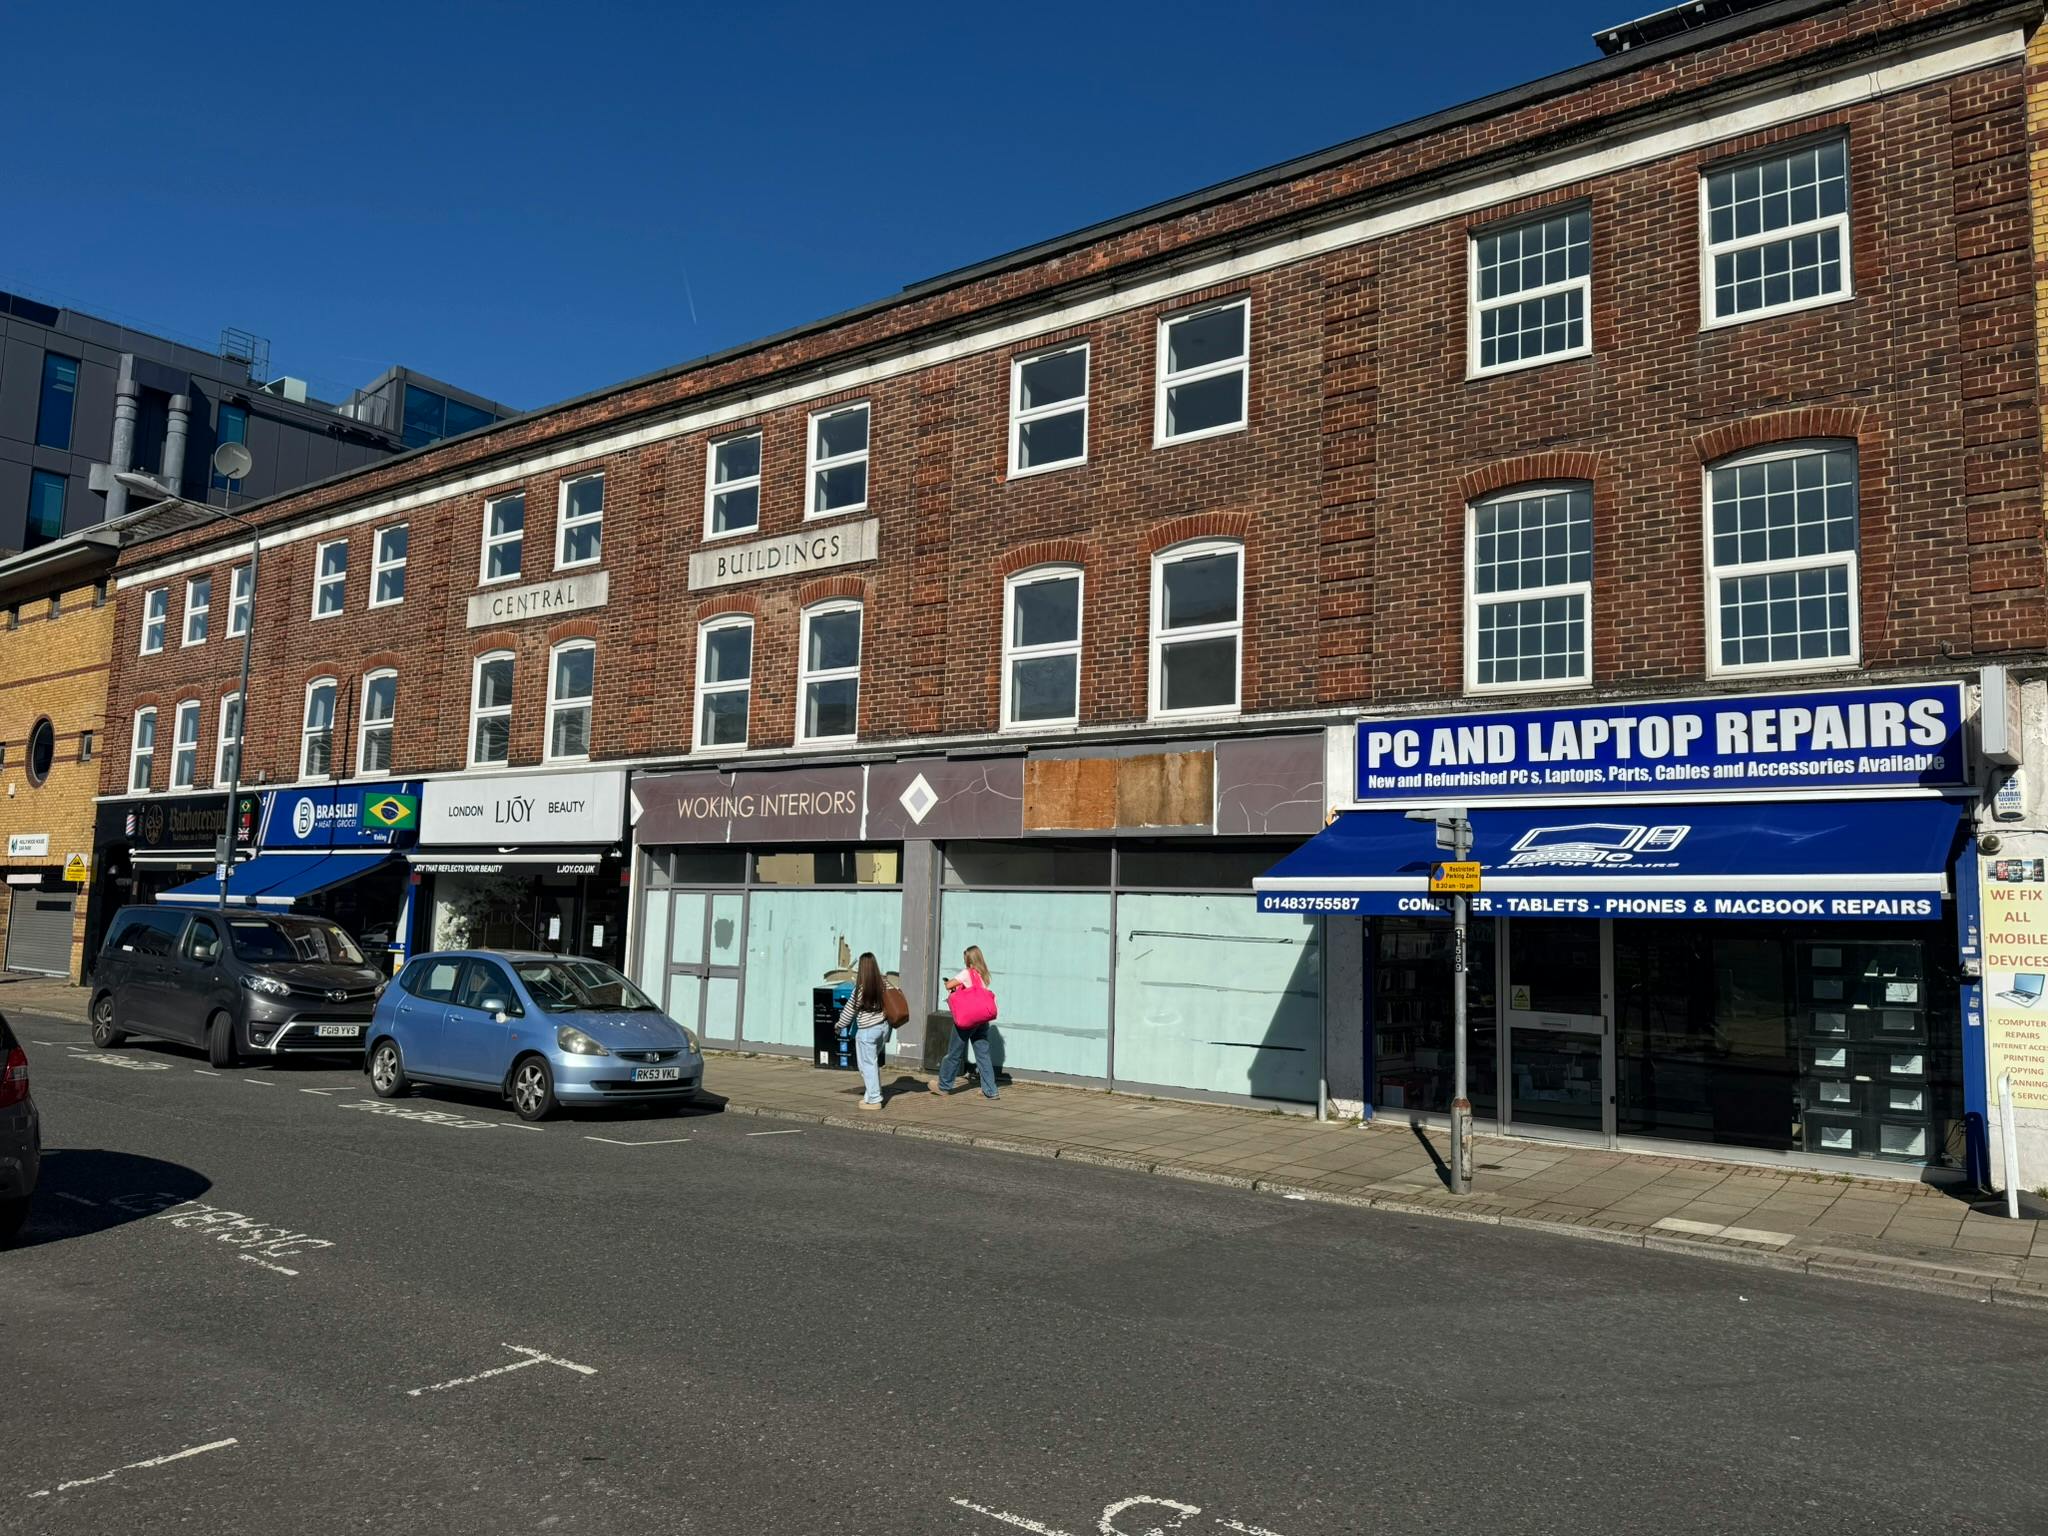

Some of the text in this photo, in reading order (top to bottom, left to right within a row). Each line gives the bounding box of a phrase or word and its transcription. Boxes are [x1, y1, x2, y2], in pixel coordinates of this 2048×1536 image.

[717, 534, 840, 577] BUILDINGS
[492, 584, 576, 617] CENTRAL
[1368, 699, 1946, 768] PC AND LAPTOP REPAIRS
[1368, 775, 1395, 788] New
[1398, 774, 1421, 788] and
[1425, 770, 1506, 787] Refurbished
[1545, 767, 1606, 785] Laptops,
[1608, 765, 1652, 783] Parts,
[1655, 761, 1710, 781] Cables
[1713, 761, 1744, 778] and
[1748, 755, 1855, 778] Accessories
[1858, 753, 1945, 773] Available
[448, 805, 483, 817] LONDON
[548, 800, 585, 813] BEAUTY
[677, 790, 857, 819] WOKING INTERIORS
[414, 864, 503, 873] JOY THAT REFLECTS YOUR BEAUTY
[556, 865, 596, 873] LJOY.CO.UK
[1990, 889, 2042, 900] WE FIX
[1264, 897, 1360, 911] 01483755587
[1398, 897, 1491, 912] COMPUER
[1508, 898, 1590, 912] TABLETS
[1606, 898, 1687, 913] PHONES
[1693, 899, 1708, 913] &
[1714, 899, 1825, 915] MACBOOK
[1831, 899, 1931, 915] REPAIRS
[2004, 912, 2031, 922] ALL
[1989, 933, 2048, 944] MOBILE
[1998, 1018, 2047, 1027] COMPUTER
[321, 1026, 359, 1037] FG19 YVS
[2005, 1031, 2041, 1039] REPAIRS
[1992, 1042, 2028, 1050] INTERNET
[2003, 1054, 2045, 1063] PRINTING
[636, 1067, 679, 1081] RK53 VKL
